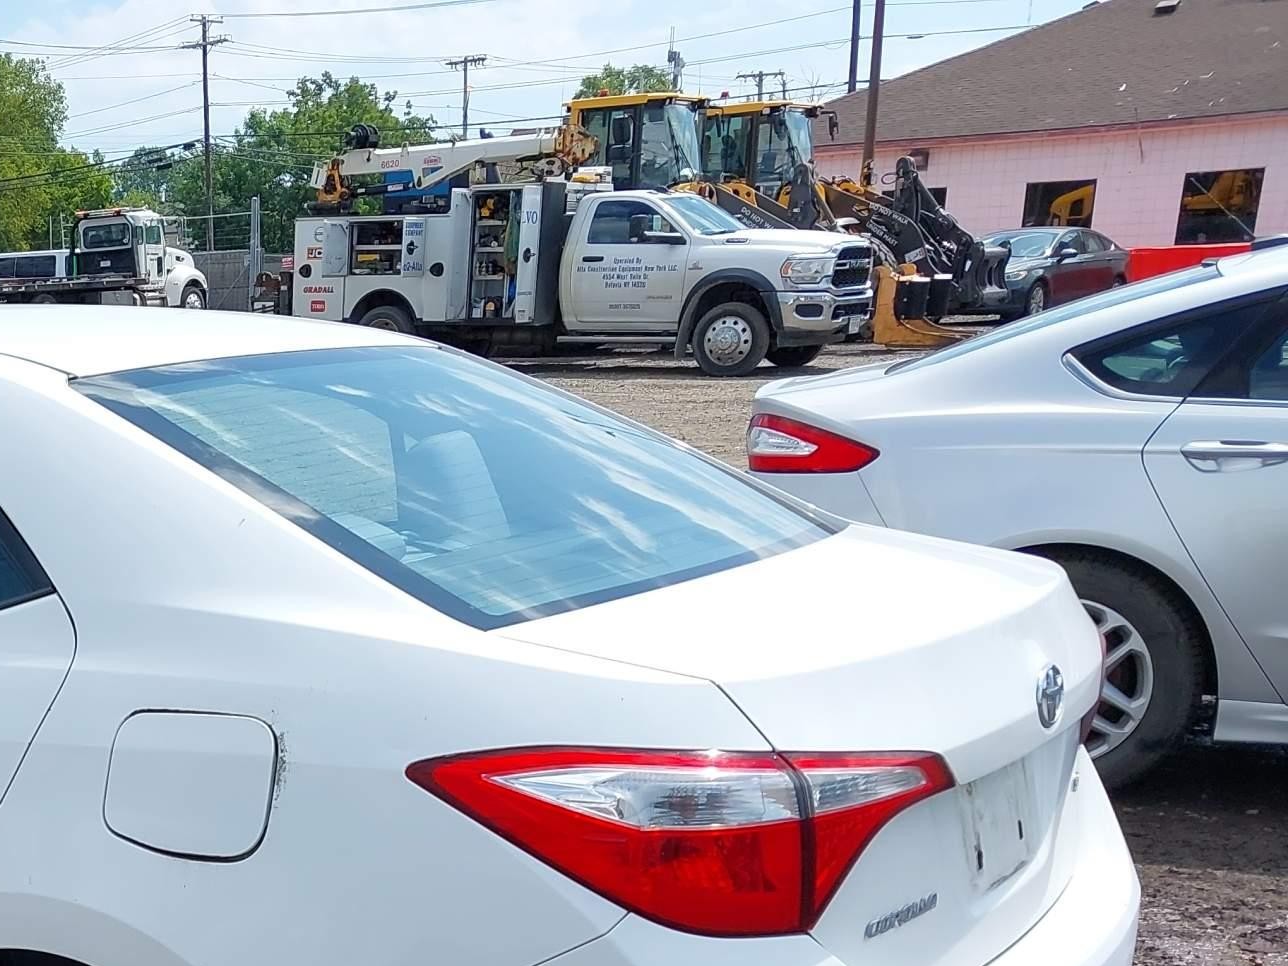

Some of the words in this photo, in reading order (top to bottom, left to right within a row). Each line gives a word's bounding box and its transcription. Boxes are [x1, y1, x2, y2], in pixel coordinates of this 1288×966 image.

[381, 159, 400, 169] 6620
[741, 206, 751, 216] DO
[750, 212, 764, 225] NOT
[892, 211, 909, 225] WALK
[882, 232, 899, 248] MAST
[864, 892, 938, 939] COROLLA
